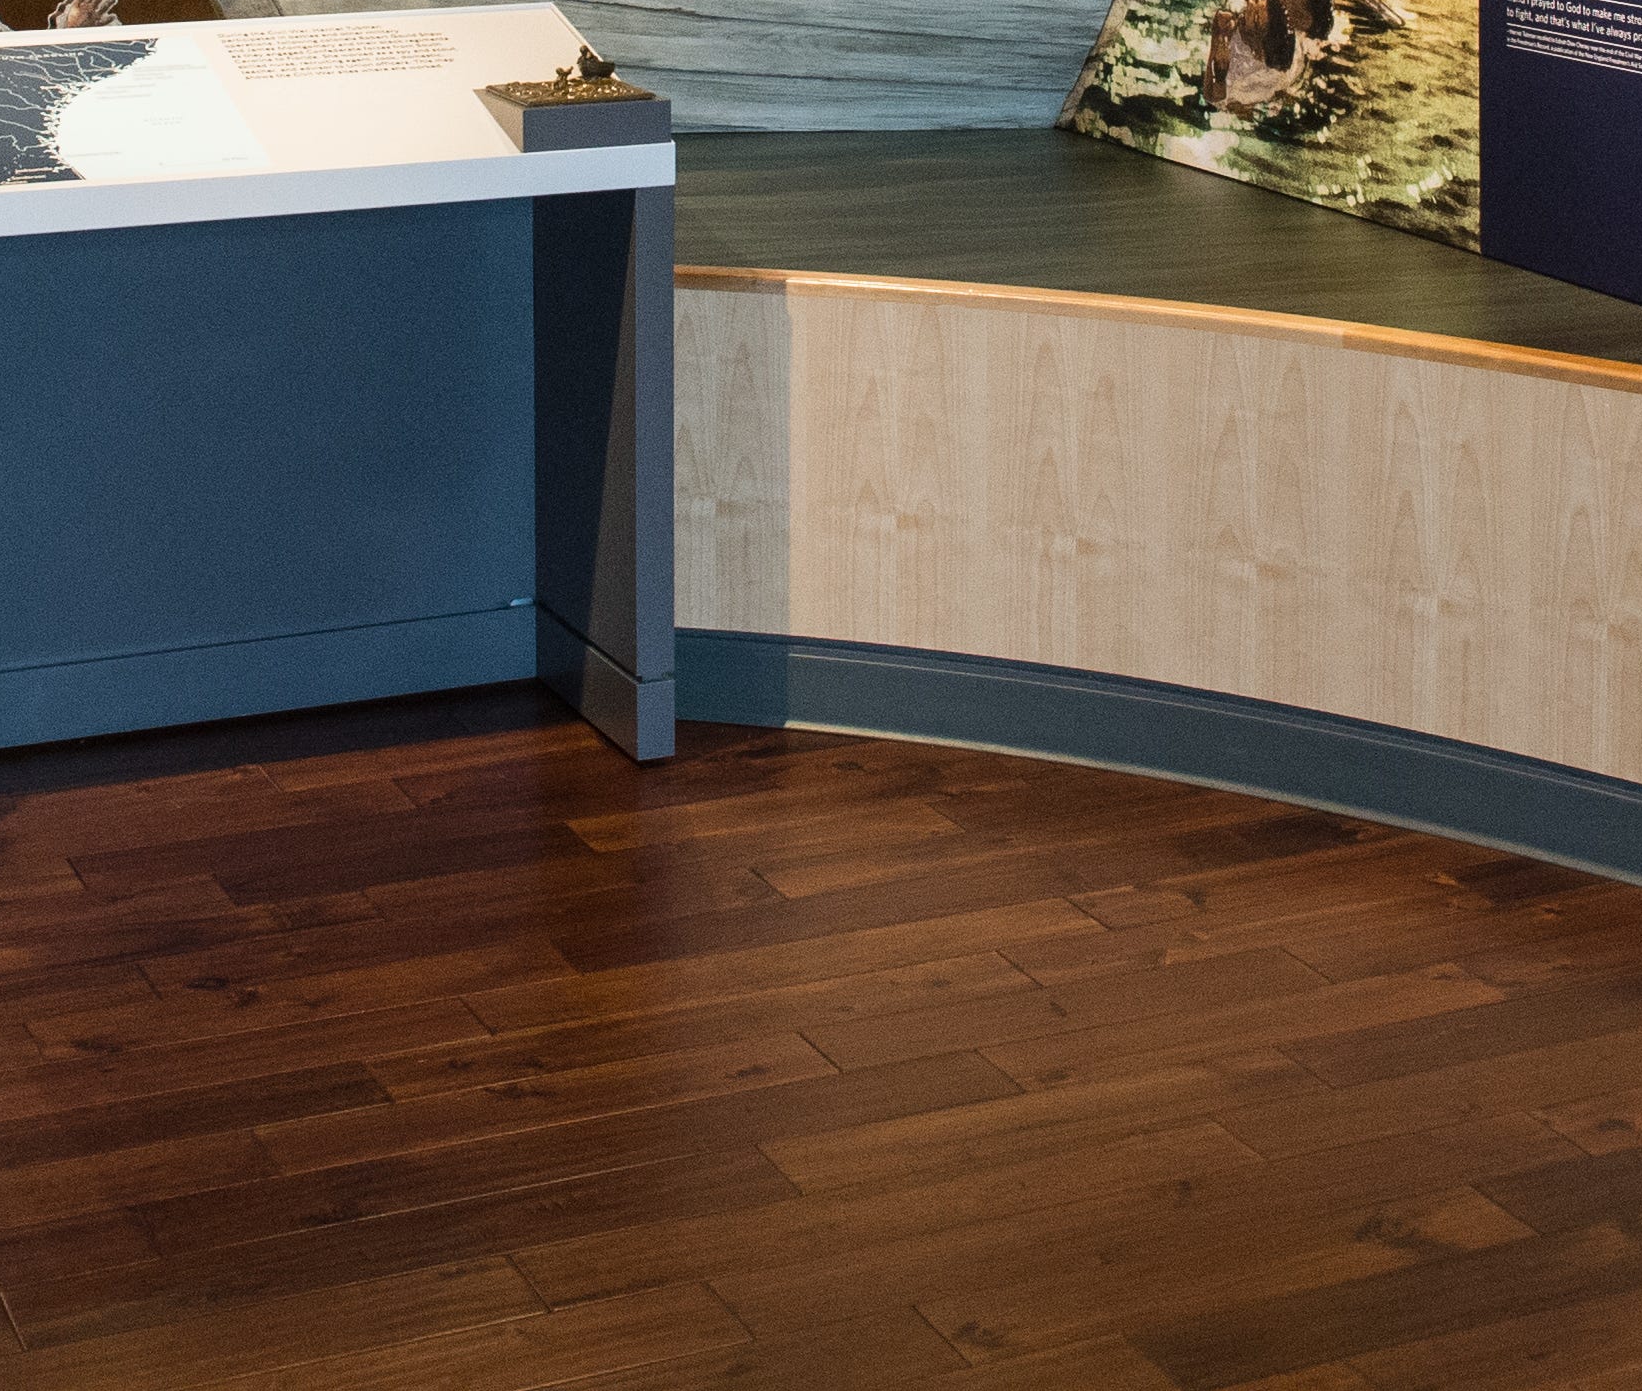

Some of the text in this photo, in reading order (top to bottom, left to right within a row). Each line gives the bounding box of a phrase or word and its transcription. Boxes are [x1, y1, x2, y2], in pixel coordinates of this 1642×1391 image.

[1507, 8, 1514, 17] to
[1515, 8, 1533, 21] fight,
[1535, 14, 1548, 24] and
[1572, 20, 1590, 32] what
[1606, 26, 1631, 41] always
[1557, 1, 1564, 11] to
[1566, 2, 1581, 14] God
[1583, 6, 1591, 16] to
[1592, 8, 1612, 20] make
[1613, 13, 1625, 22] me
